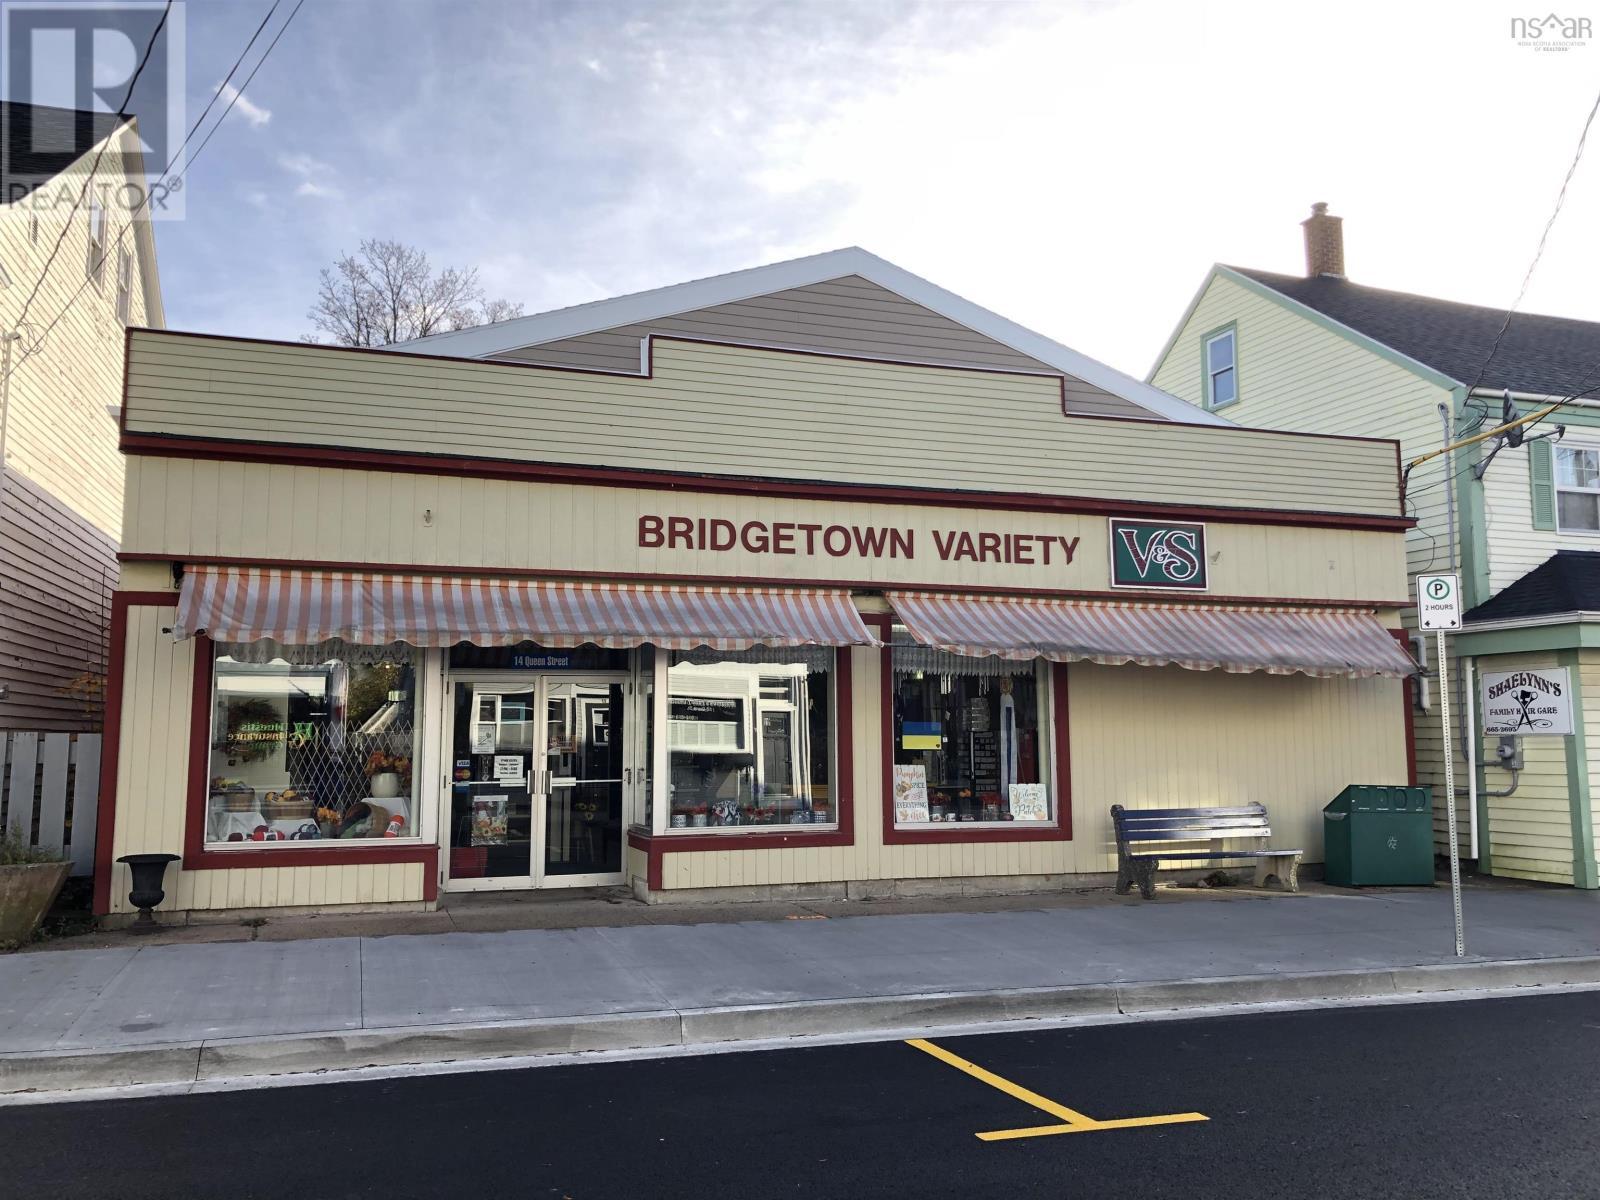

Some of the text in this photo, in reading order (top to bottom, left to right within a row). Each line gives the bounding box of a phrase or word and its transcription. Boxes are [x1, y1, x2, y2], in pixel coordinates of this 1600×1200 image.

[638, 515, 1081, 566] BRIDGETOWN VARIETY
[1118, 528, 1199, 581] V&S
[1434, 583, 1443, 596] P
[1430, 603, 1454, 611] HOURS
[514, 655, 569, 667] 14 Queen Street
[1488, 672, 1562, 700] SHAELYNN'S
[1489, 707, 1515, 716] FAMILY
[1537, 706, 1558, 715] CARE
